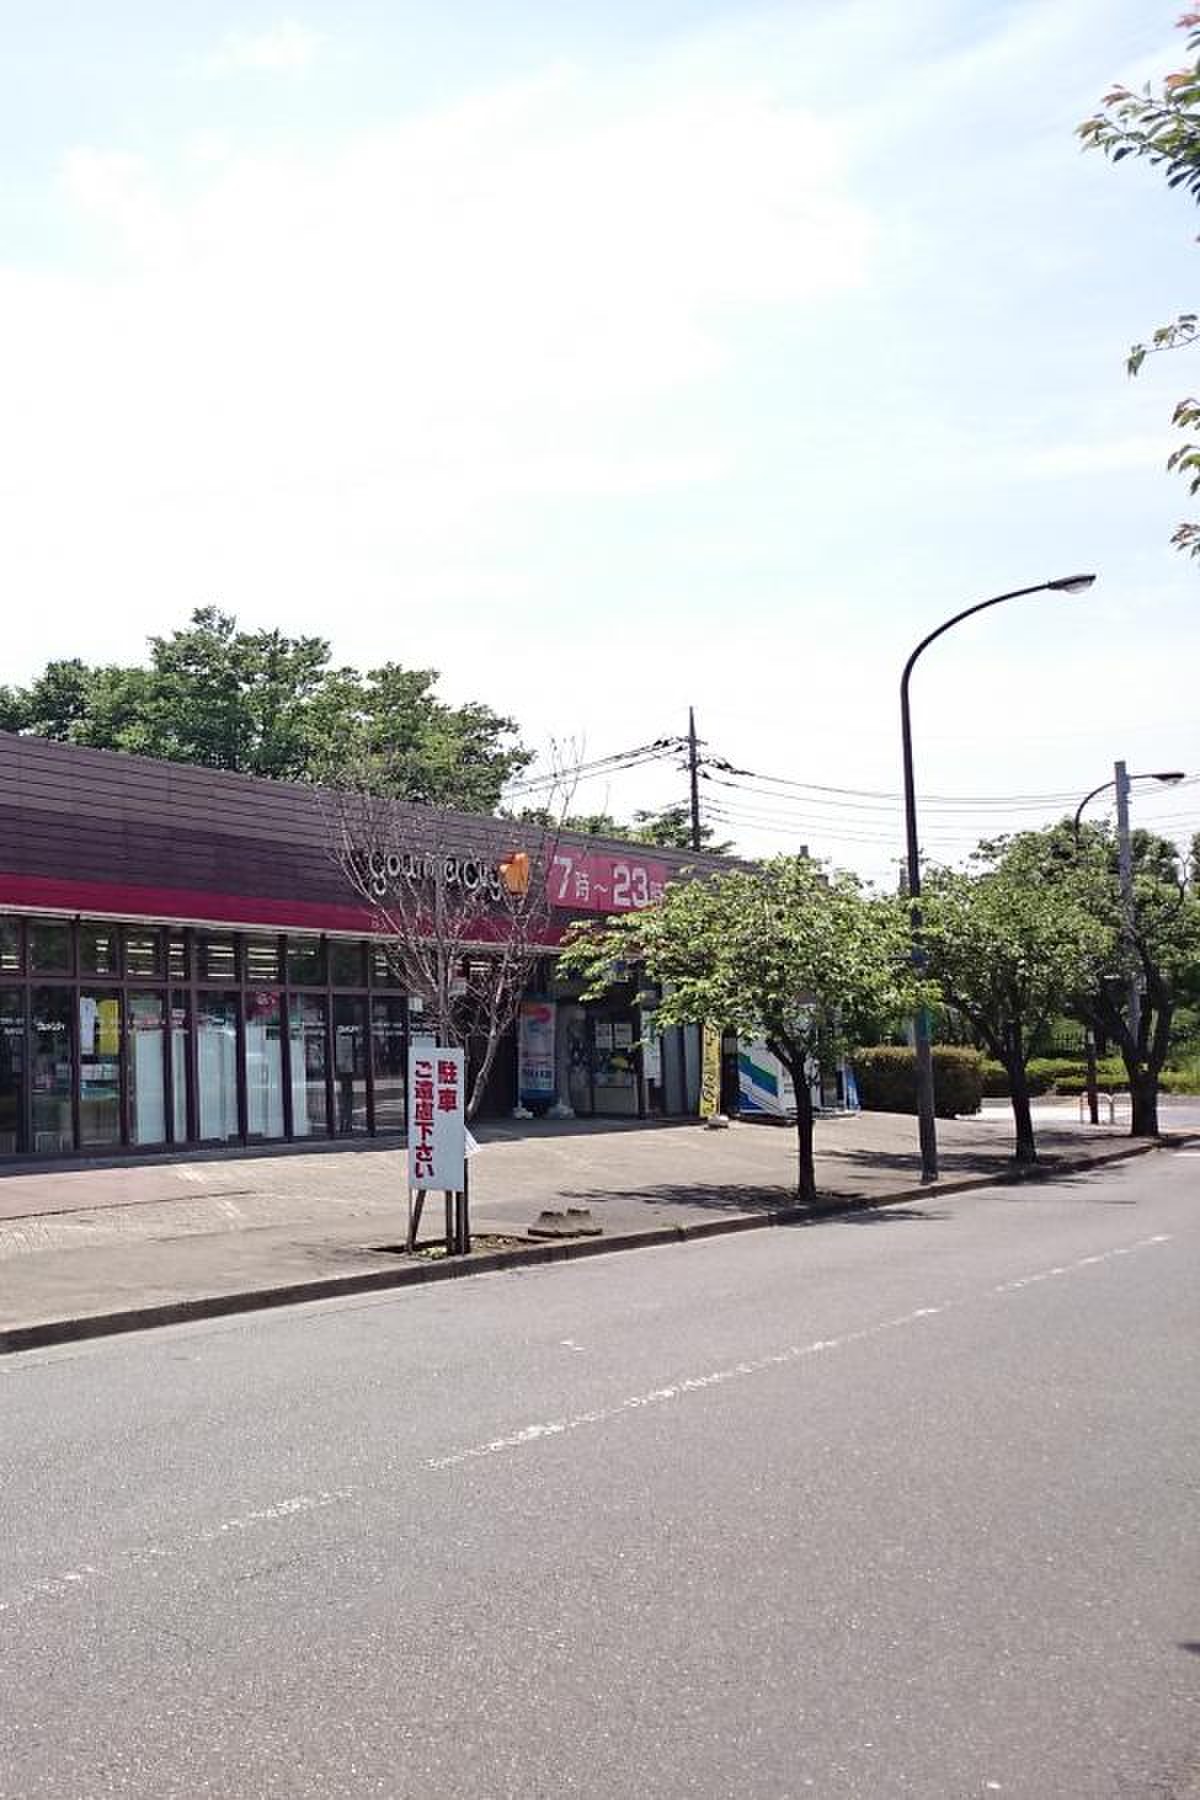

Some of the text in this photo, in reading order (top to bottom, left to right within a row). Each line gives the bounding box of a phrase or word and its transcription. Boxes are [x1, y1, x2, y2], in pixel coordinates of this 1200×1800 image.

[413, 1059, 435, 1179] ご遠慮下さい
[436, 1059, 458, 1112] 駐車
